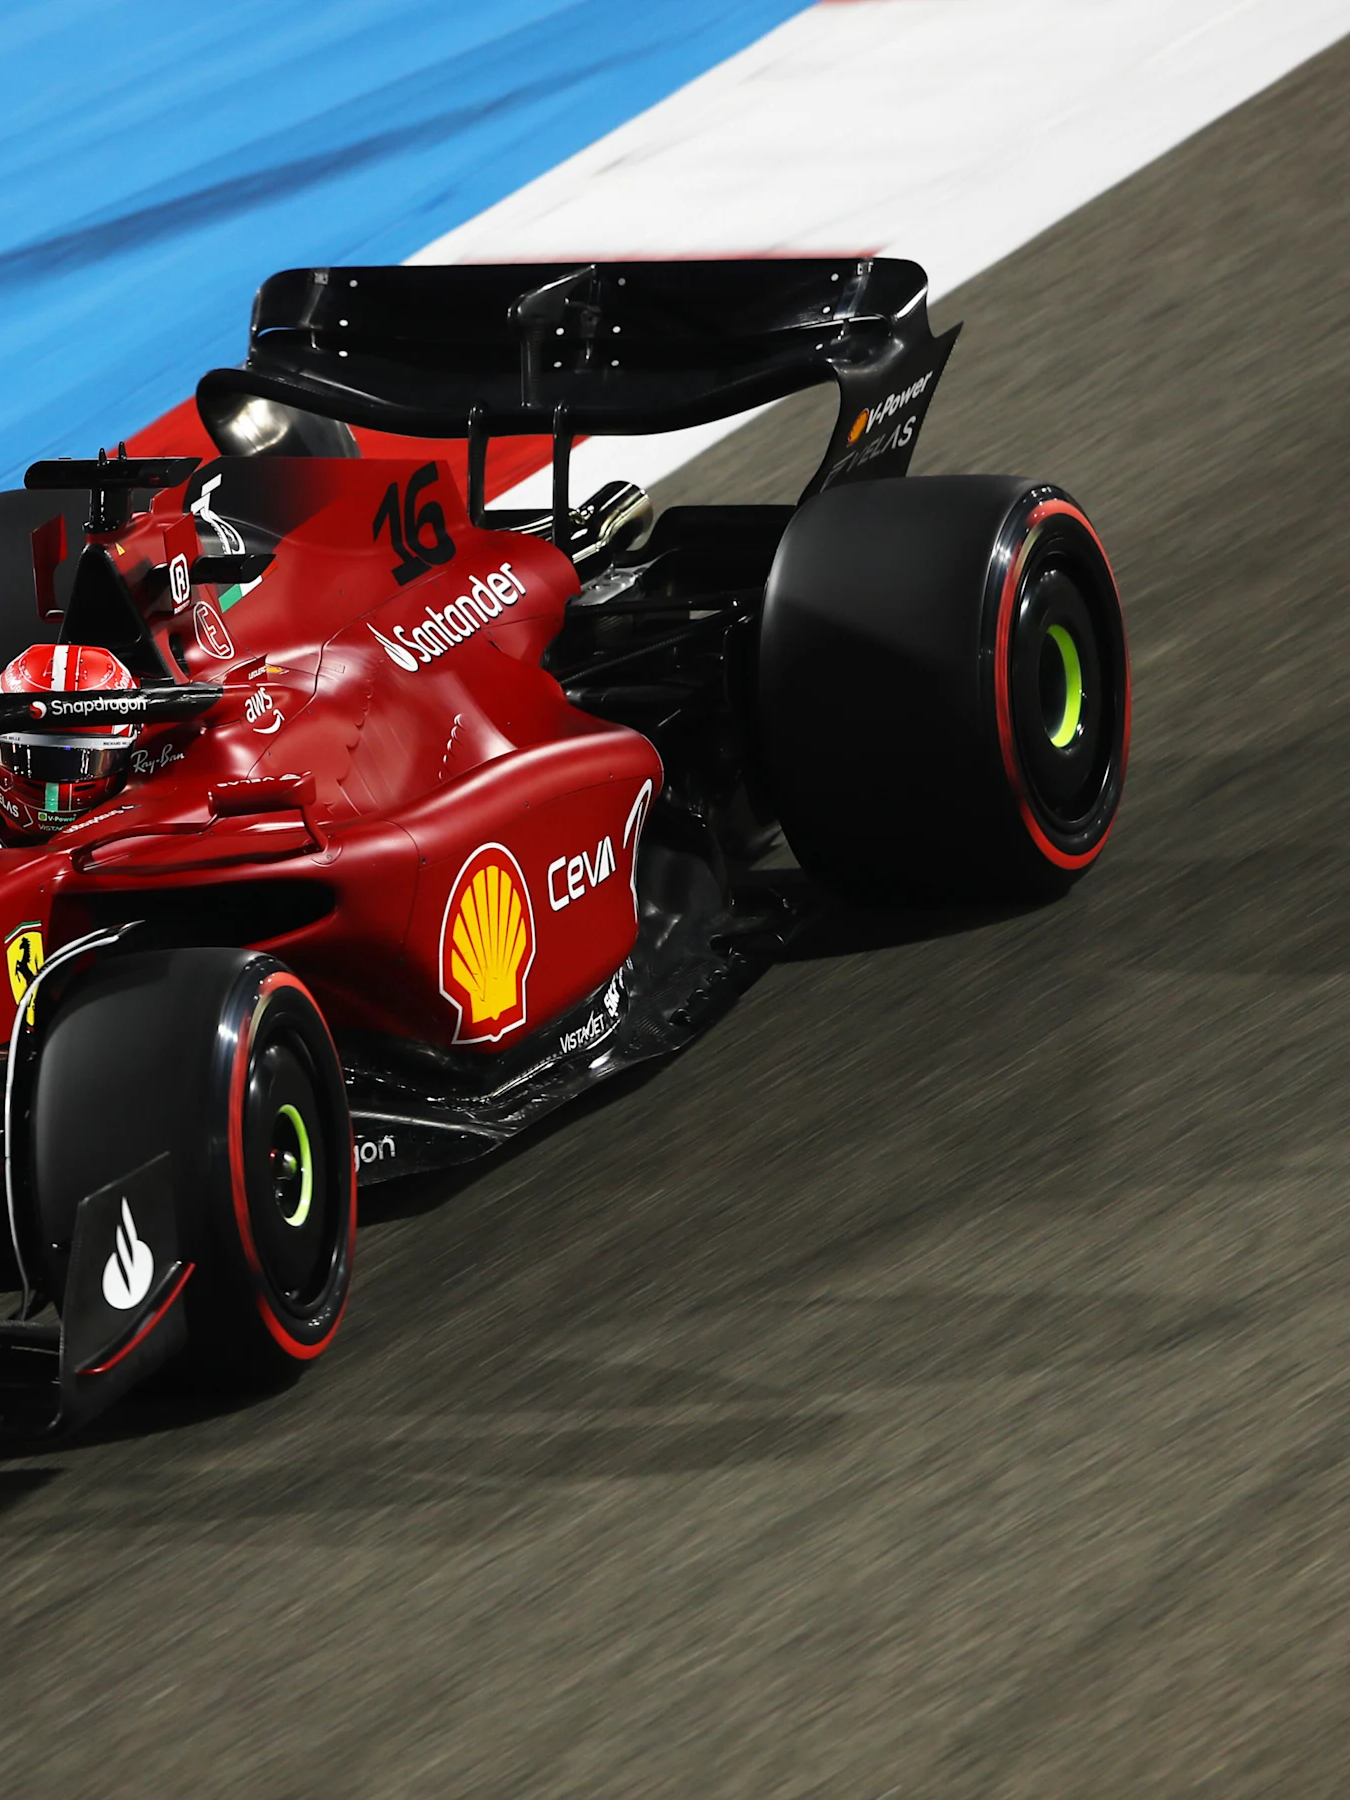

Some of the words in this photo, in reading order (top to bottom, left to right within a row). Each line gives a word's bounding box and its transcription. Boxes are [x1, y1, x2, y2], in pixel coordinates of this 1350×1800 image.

[866, 371, 933, 434] V-Power
[372, 461, 457, 586] 16
[394, 562, 527, 663] Santander
[51, 697, 147, 716] Snapdragon
[245, 687, 273, 723] aws
[130, 743, 185, 774] Ray-Ban
